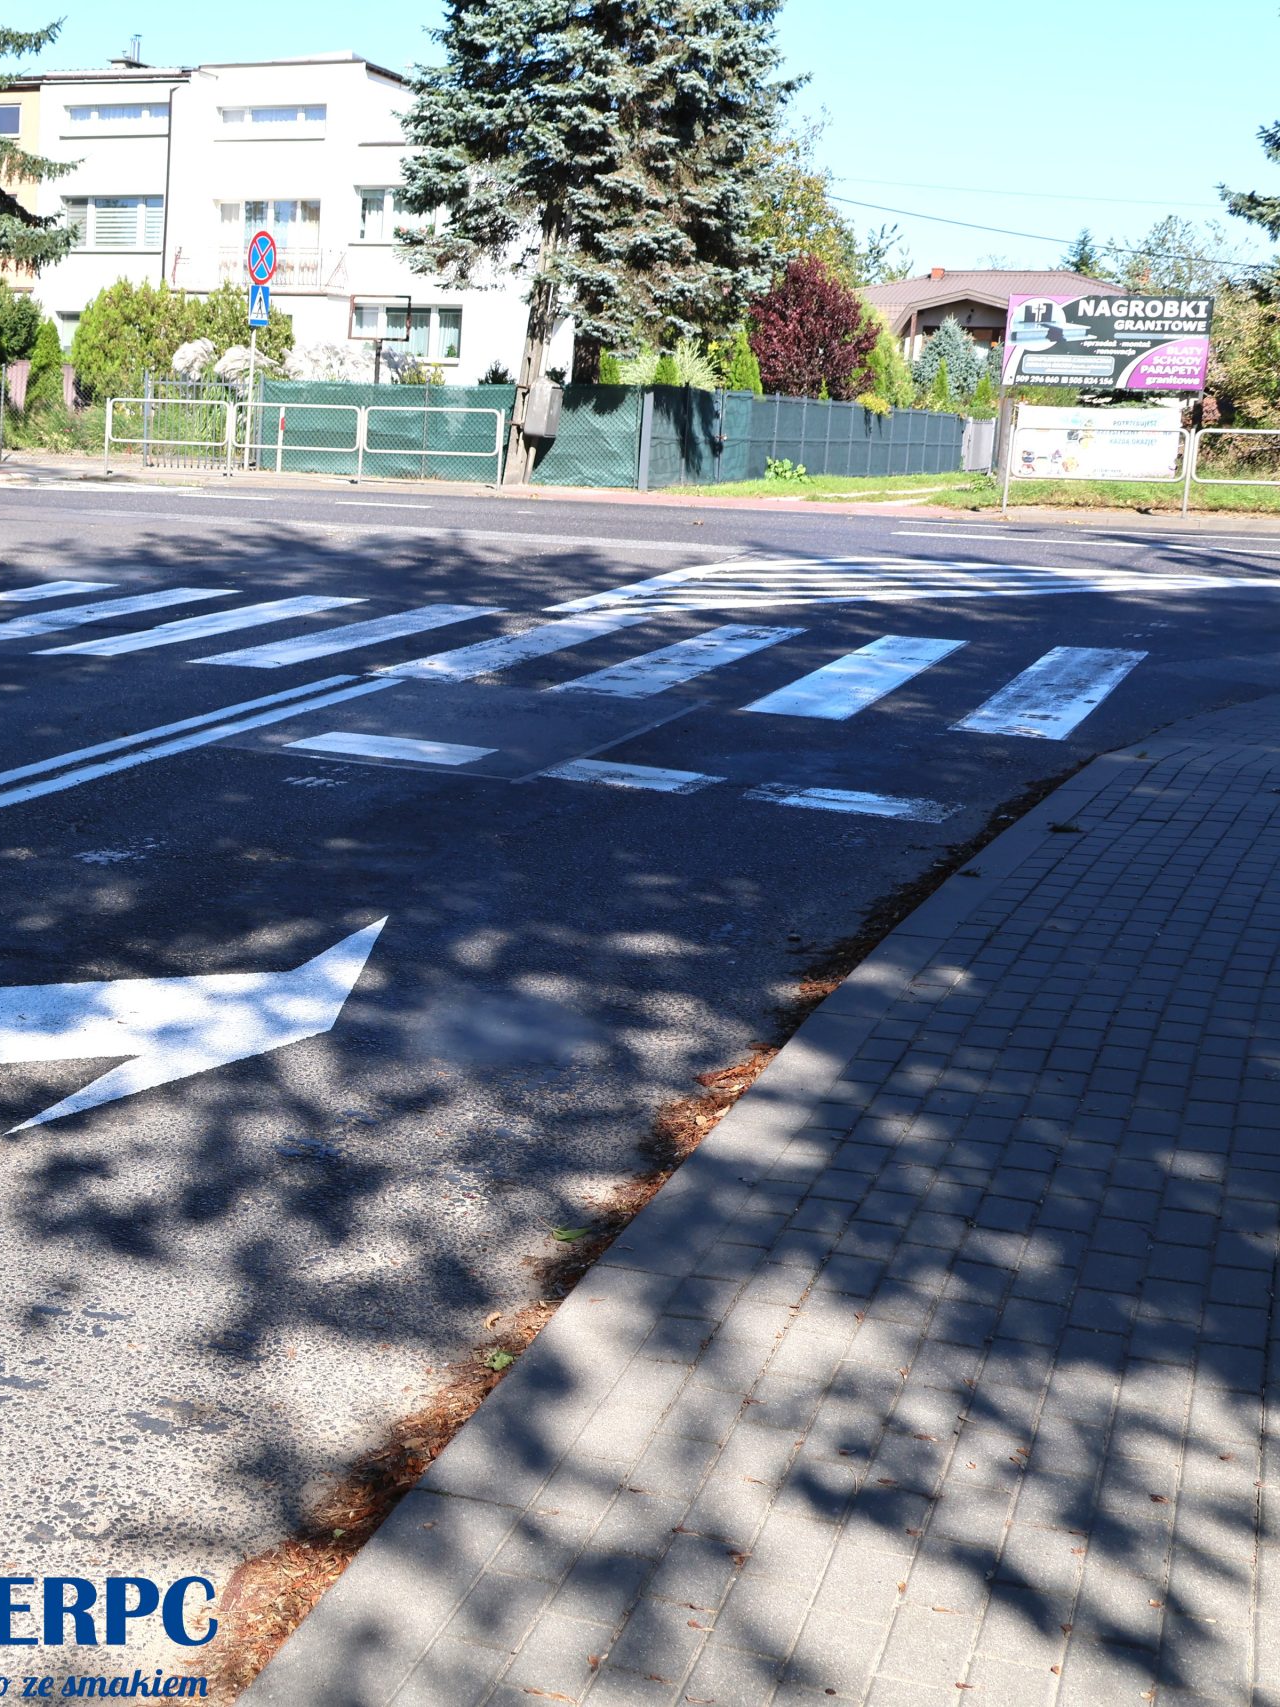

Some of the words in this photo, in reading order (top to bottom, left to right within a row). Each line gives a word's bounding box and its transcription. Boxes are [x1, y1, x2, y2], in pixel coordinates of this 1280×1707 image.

[1077, 299, 1209, 318] NAGROBKI
[1113, 320, 1207, 332] GRANITOWE
[1166, 346, 1203, 355] BLATY
[1153, 355, 1203, 365] SCHODY
[1140, 365, 1201, 374] PARAPETY
[1145, 375, 1201, 385] granitowe
